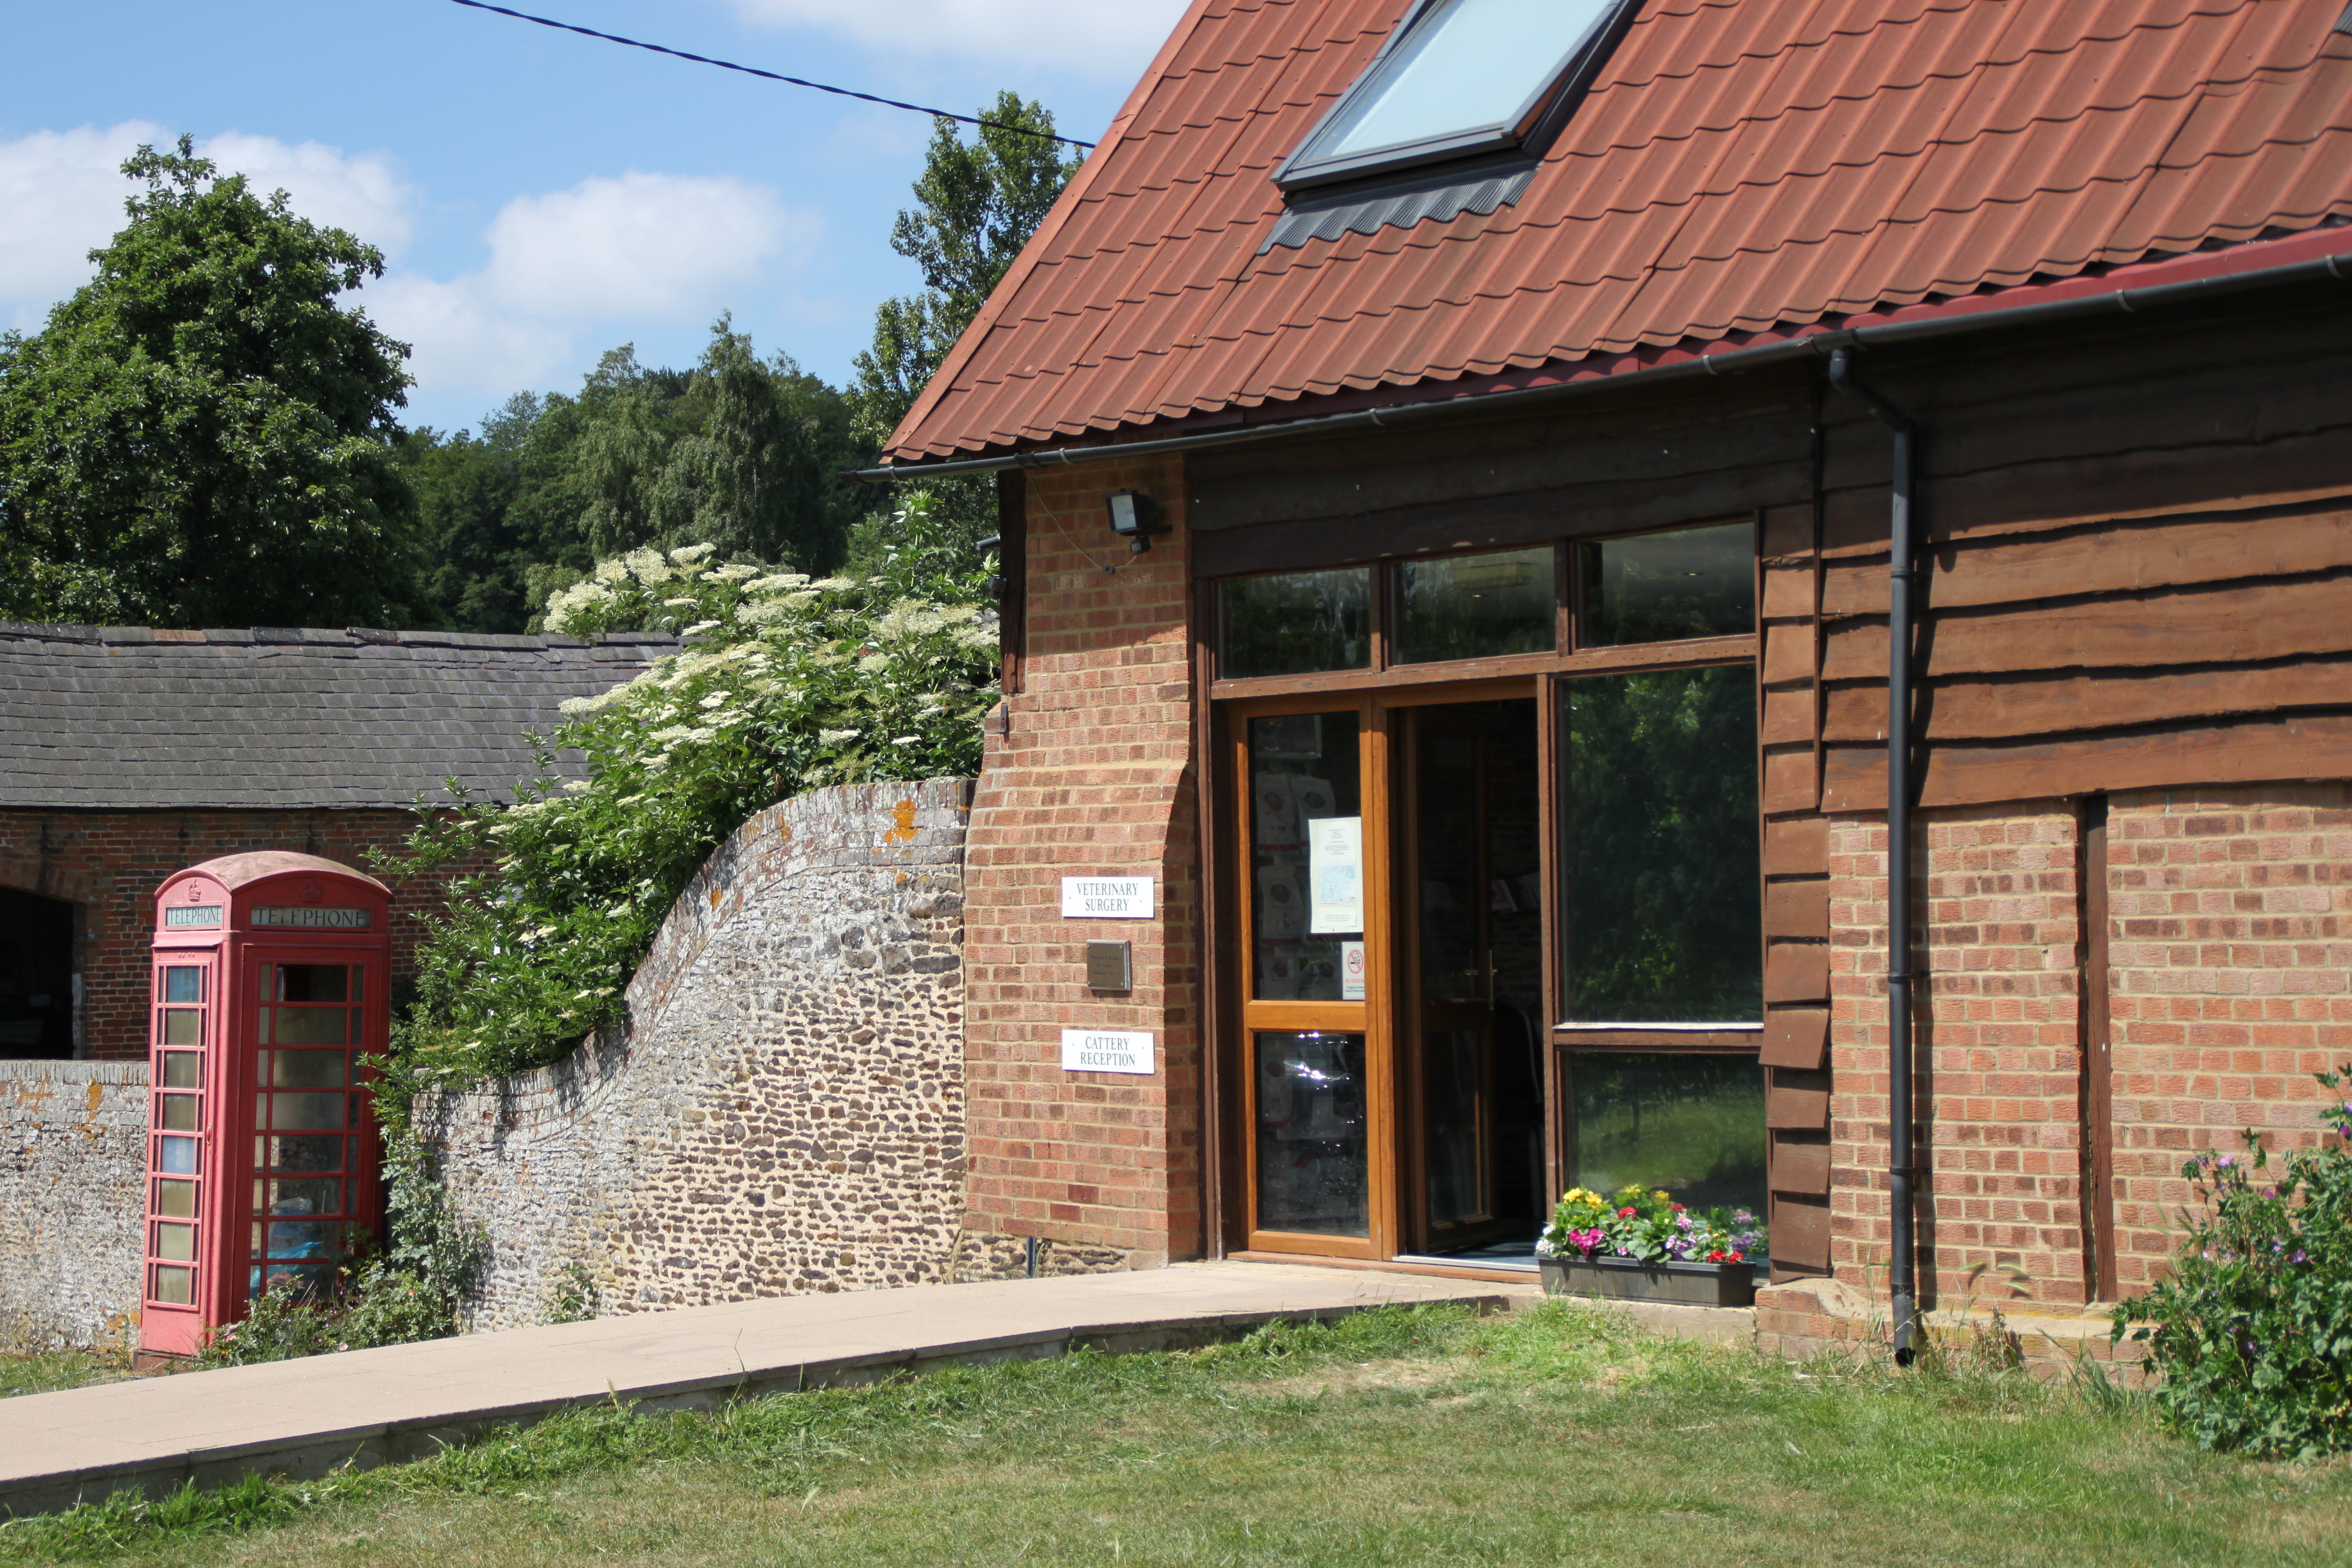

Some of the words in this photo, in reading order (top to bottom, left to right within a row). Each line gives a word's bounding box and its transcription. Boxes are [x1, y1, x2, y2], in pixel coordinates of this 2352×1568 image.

[1077, 883, 1138, 895] VETERINARY
[1085, 898, 1129, 911] SURGERY
[169, 907, 221, 925] TELEPHONE
[256, 908, 365, 927] TELEPHONE
[1085, 1036, 1130, 1050] CATTERY
[1080, 1052, 1135, 1067] RECEPTION
